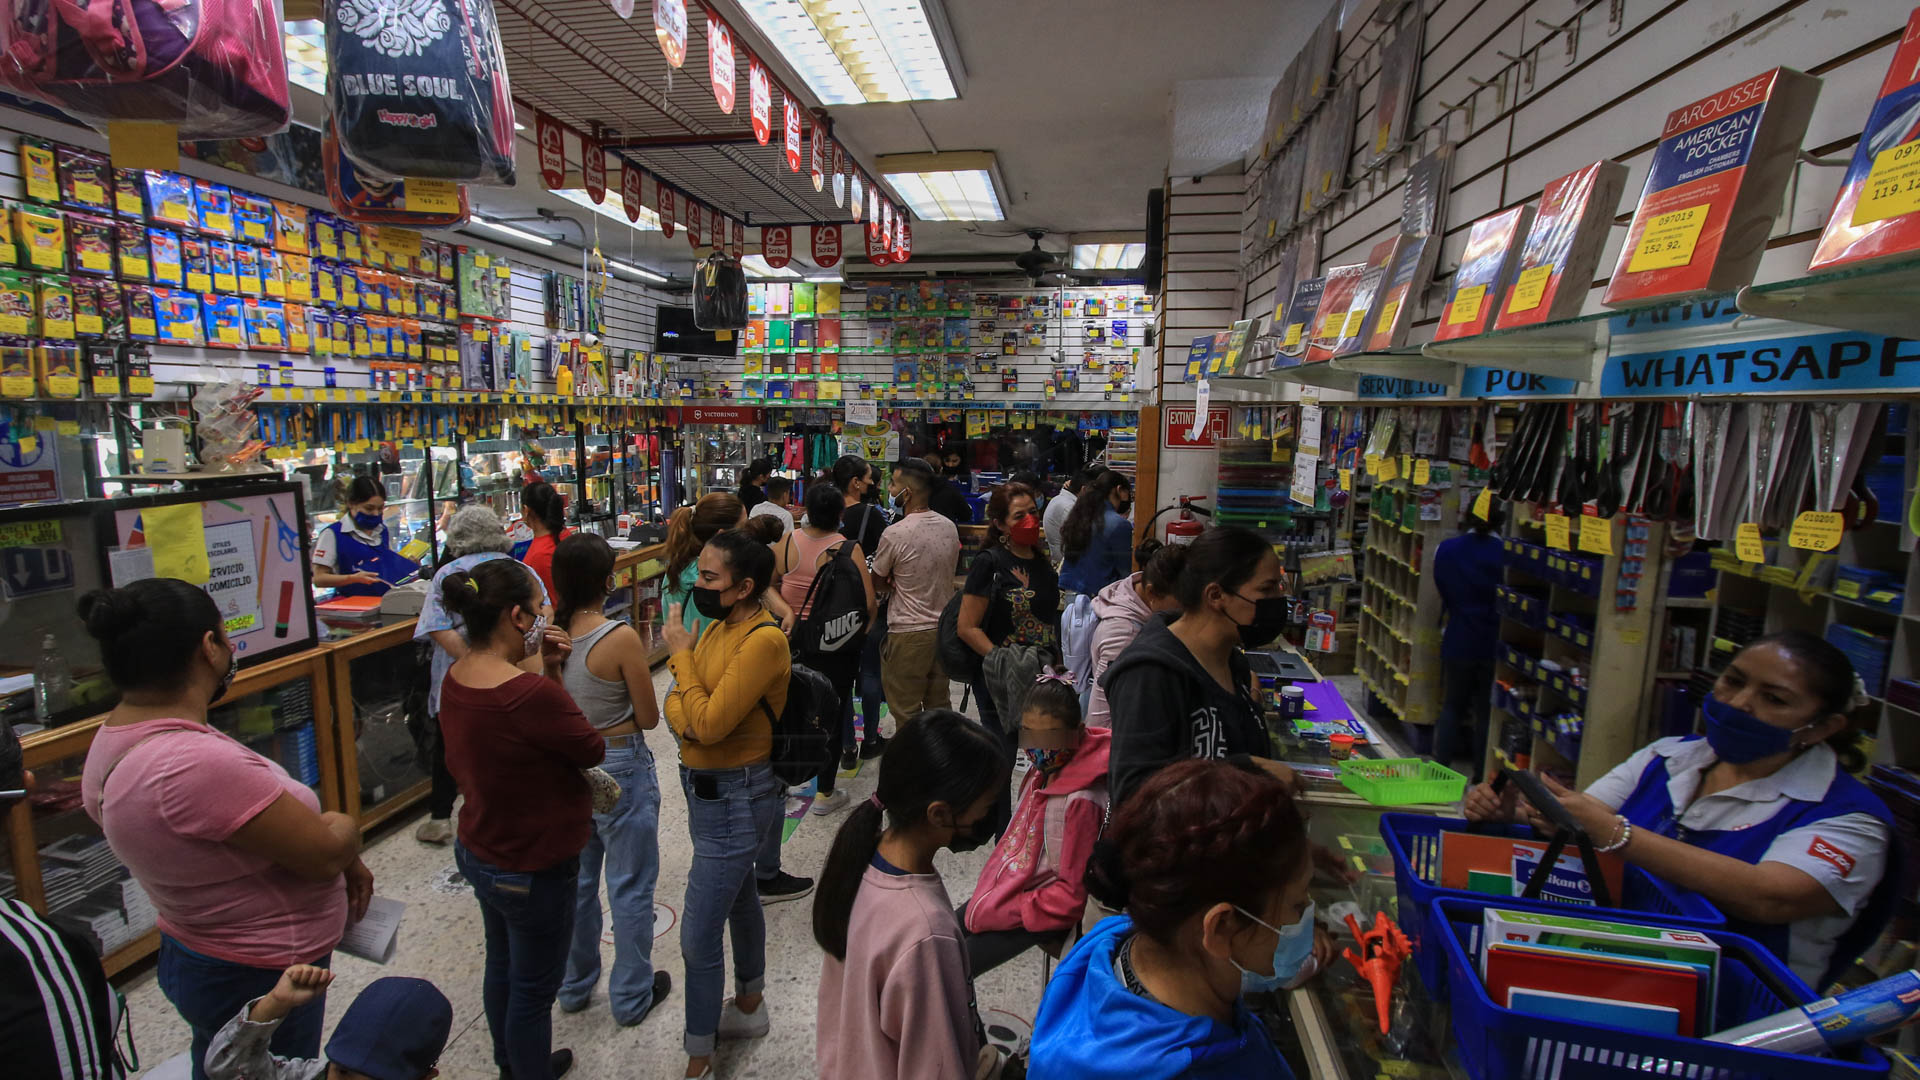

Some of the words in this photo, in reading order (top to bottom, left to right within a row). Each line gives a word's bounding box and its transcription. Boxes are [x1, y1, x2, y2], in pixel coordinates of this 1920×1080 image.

[343, 73, 398, 95] BLUE
[403, 75, 463, 100] SOUL
[1666, 78, 1766, 134] LAROUSSE
[419, 113, 437, 129] girl
[1674, 111, 1754, 152] AMERICAN
[1686, 129, 1748, 162] POCKET
[544, 155, 561, 168] Scribe
[1708, 150, 1740, 165] CHAMBERS
[1678, 167, 1704, 181] ENGLISH
[1704, 157, 1739, 174] DICTIONARY
[1658, 211, 1694, 226] 097019
[766, 227, 787, 244] 60
[816, 227, 837, 244] 60
[817, 246, 836, 254] Scribe
[209, 576, 251, 592] DOMICILIO
[825, 611, 861, 641] NIKE
